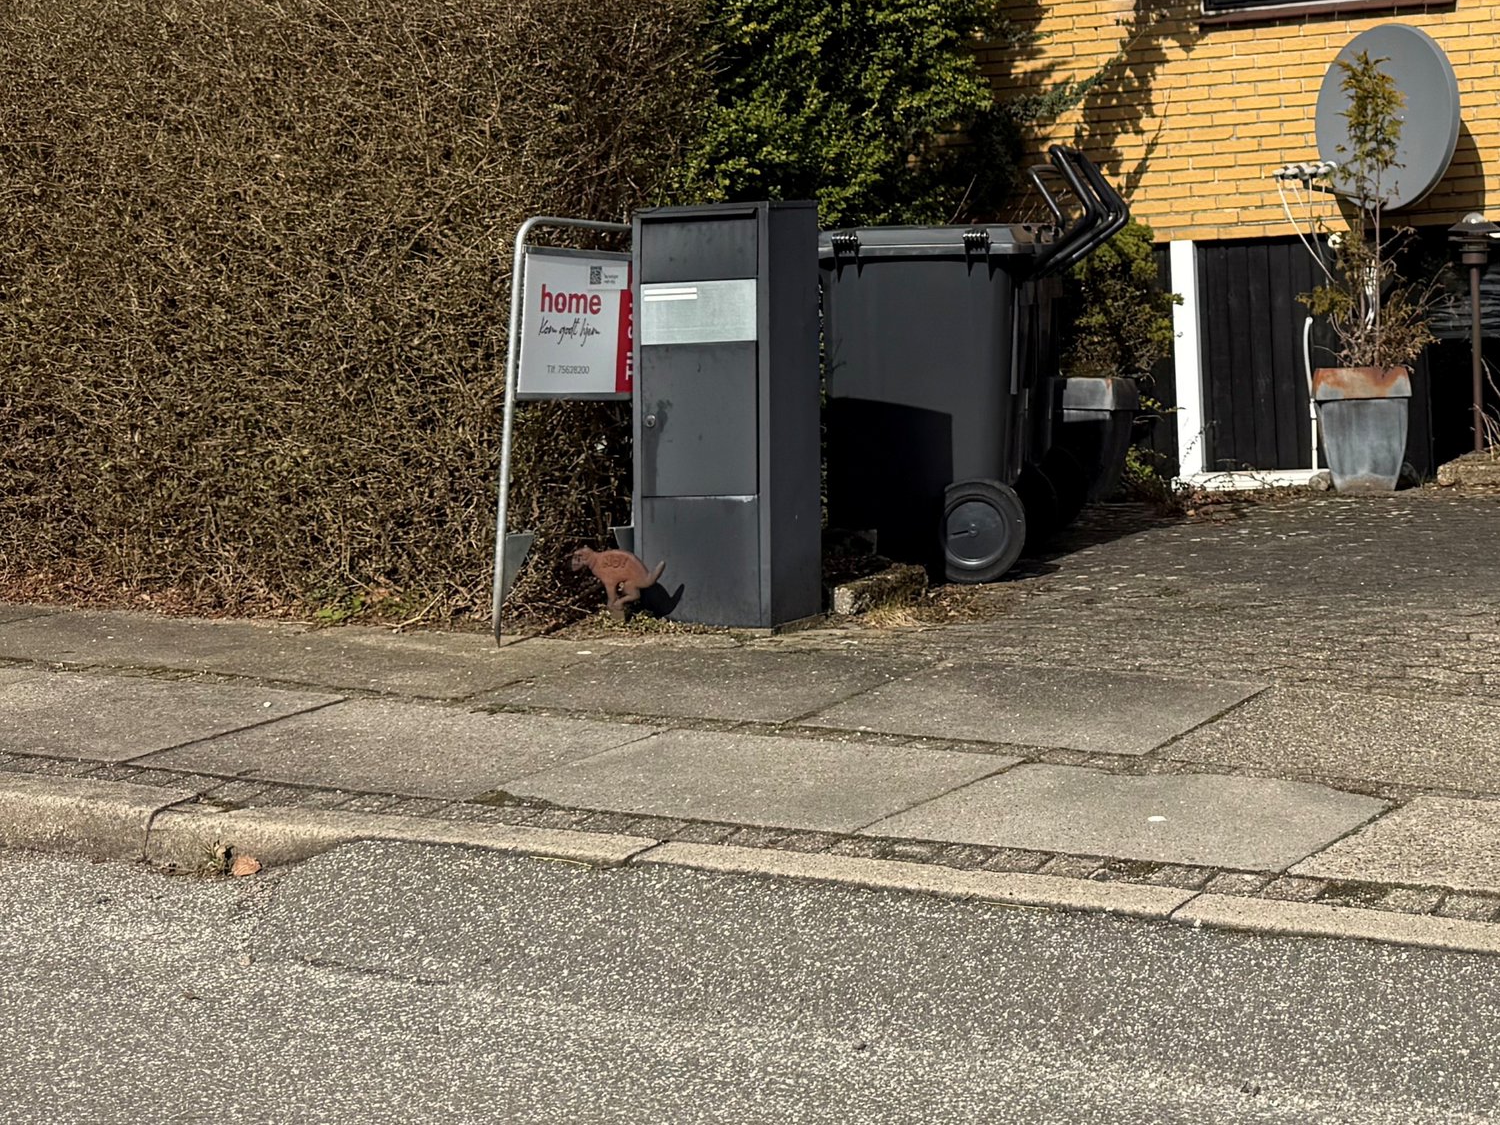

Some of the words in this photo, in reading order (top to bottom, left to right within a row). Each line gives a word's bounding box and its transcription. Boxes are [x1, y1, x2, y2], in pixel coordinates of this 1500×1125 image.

[540, 283, 602, 315] home
[538, 316, 557, 336] Kom
[557, 317, 580, 345] godt
[580, 317, 600, 347] hjem
